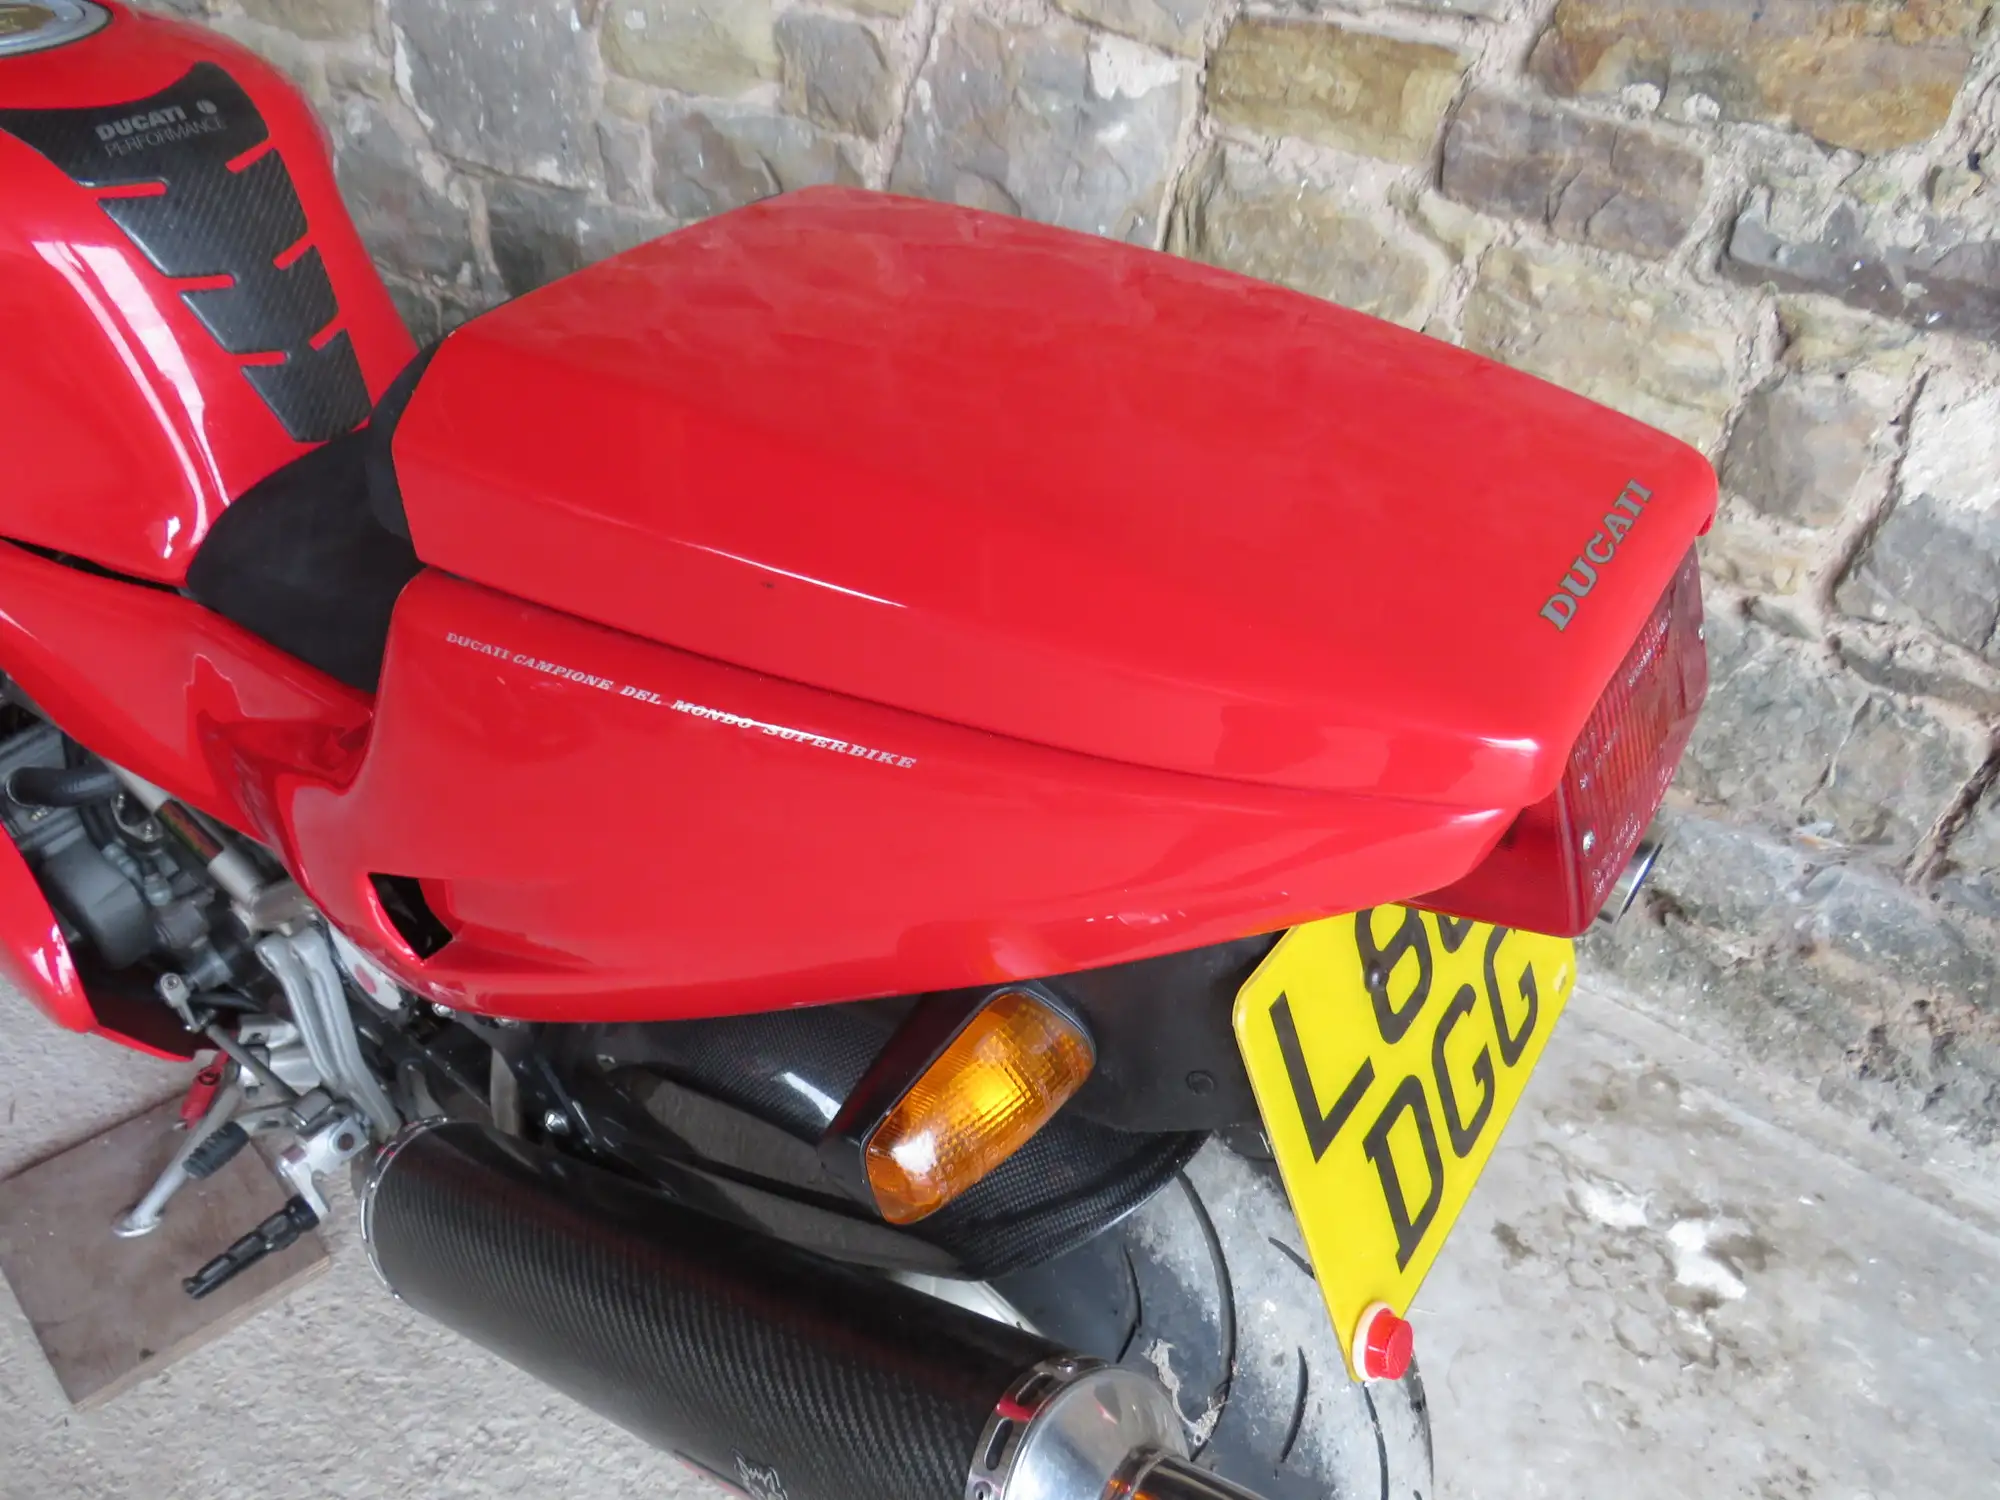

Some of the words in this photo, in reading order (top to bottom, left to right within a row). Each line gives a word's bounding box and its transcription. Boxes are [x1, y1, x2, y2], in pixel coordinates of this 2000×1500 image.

[95, 105, 188, 142] DUCATI
[104, 116, 226, 158] PERFORMANCE
[1539, 478, 1654, 632] DUCATI
[445, 632, 511, 660] DUCATI
[513, 653, 614, 690] CAMPIONE
[619, 685, 662, 705] DEL
[671, 699, 753, 729] MONDO
[762, 724, 917, 769] SUPERBIKE
[1363, 926, 1538, 1274] DGG
